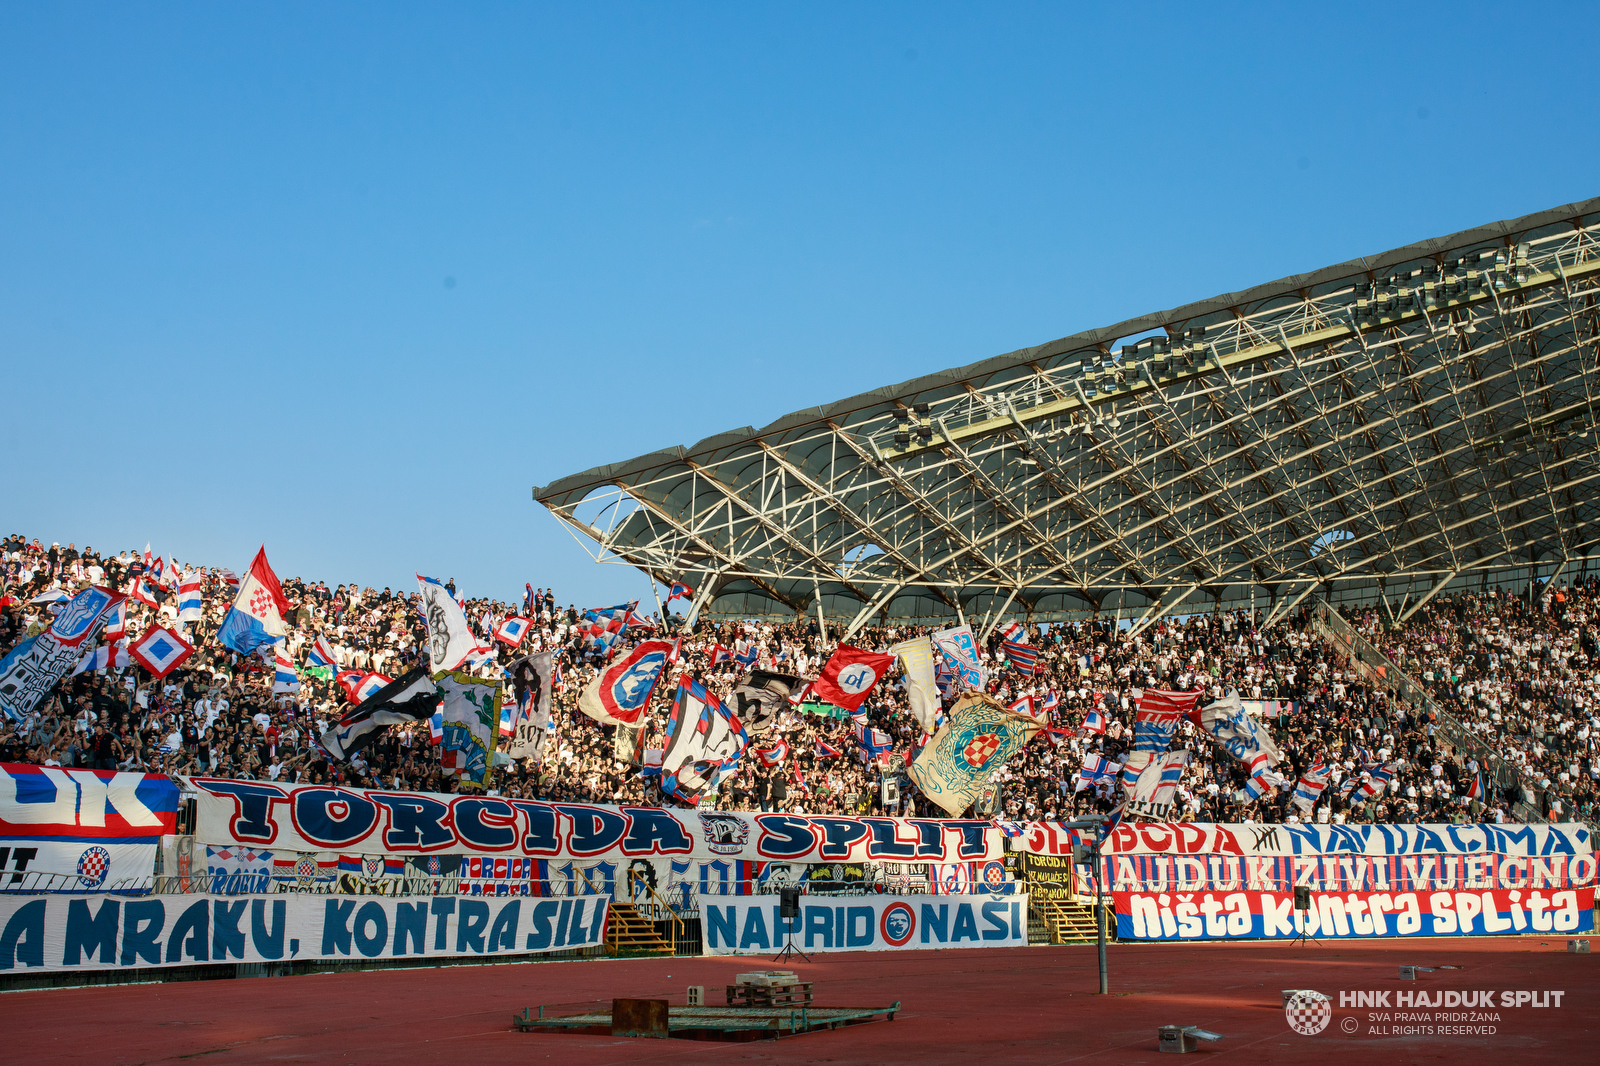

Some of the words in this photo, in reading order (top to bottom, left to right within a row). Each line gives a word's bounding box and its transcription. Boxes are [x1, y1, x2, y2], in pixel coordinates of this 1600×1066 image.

[190, 778, 693, 857] TORCIDA
[754, 813, 998, 861] SPLIT
[1028, 821, 1245, 856] SLBODA
[461, 857, 531, 879] TORCIDA
[1028, 854, 1066, 868] TORCIDA
[63, 899, 300, 966] MRAKU,
[321, 897, 521, 958] KONTRA
[526, 898, 608, 950] SILI
[921, 895, 1021, 944] NAŠI
